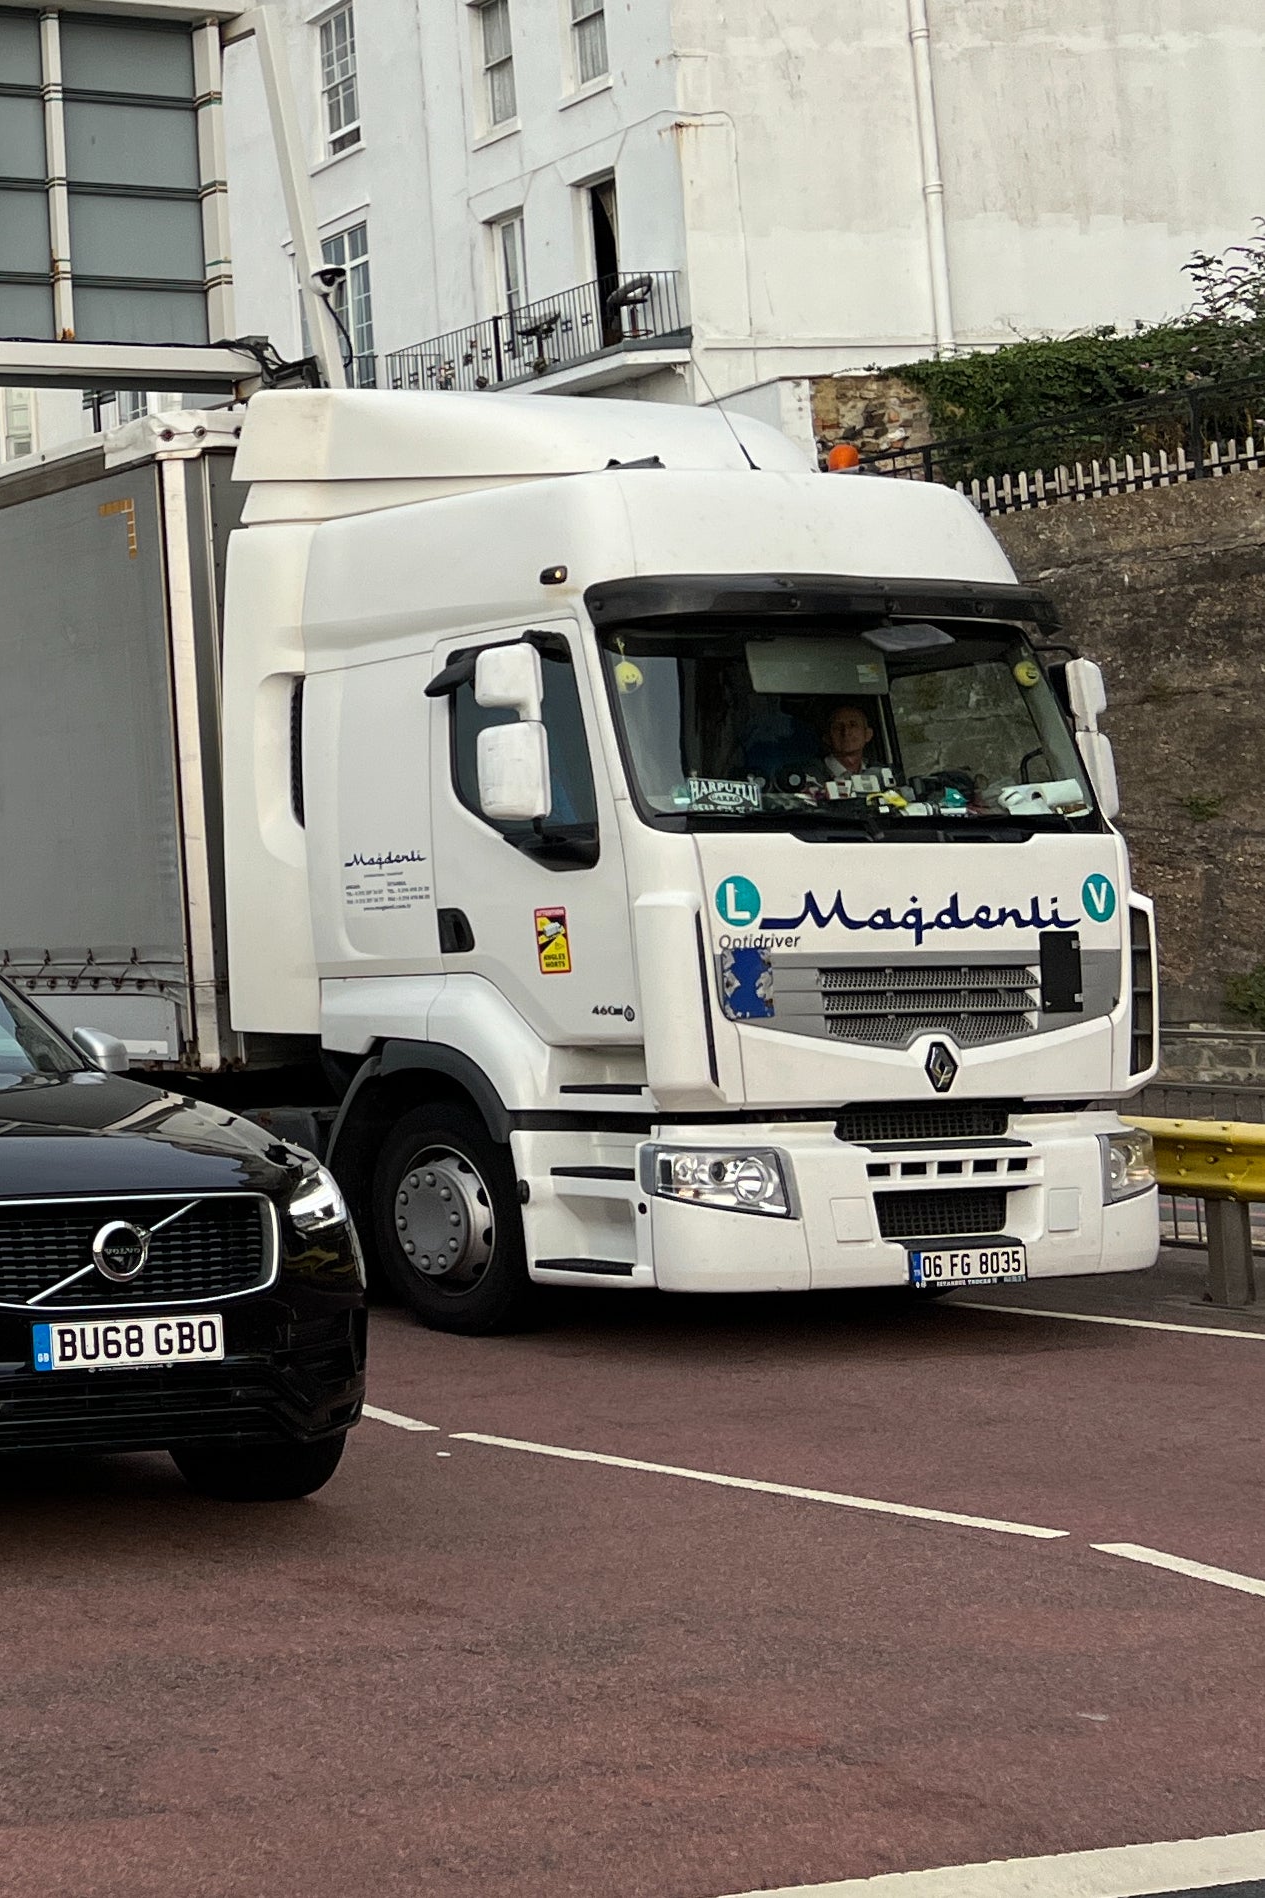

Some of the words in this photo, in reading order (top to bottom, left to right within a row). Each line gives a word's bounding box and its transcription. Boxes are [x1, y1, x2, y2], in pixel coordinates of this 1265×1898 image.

[690, 780, 759, 806] HARPUTLU
[726, 883, 751, 919] L
[1087, 882, 1108, 914] V
[104, 1247, 141, 1255] VOLVO
[923, 1255, 943, 1278] 06
[950, 1253, 971, 1277] FG
[979, 1250, 1021, 1275] 8035
[57, 1324, 144, 1362] BU68
[154, 1320, 217, 1356] GBO
[37, 1353, 50, 1362] GB
